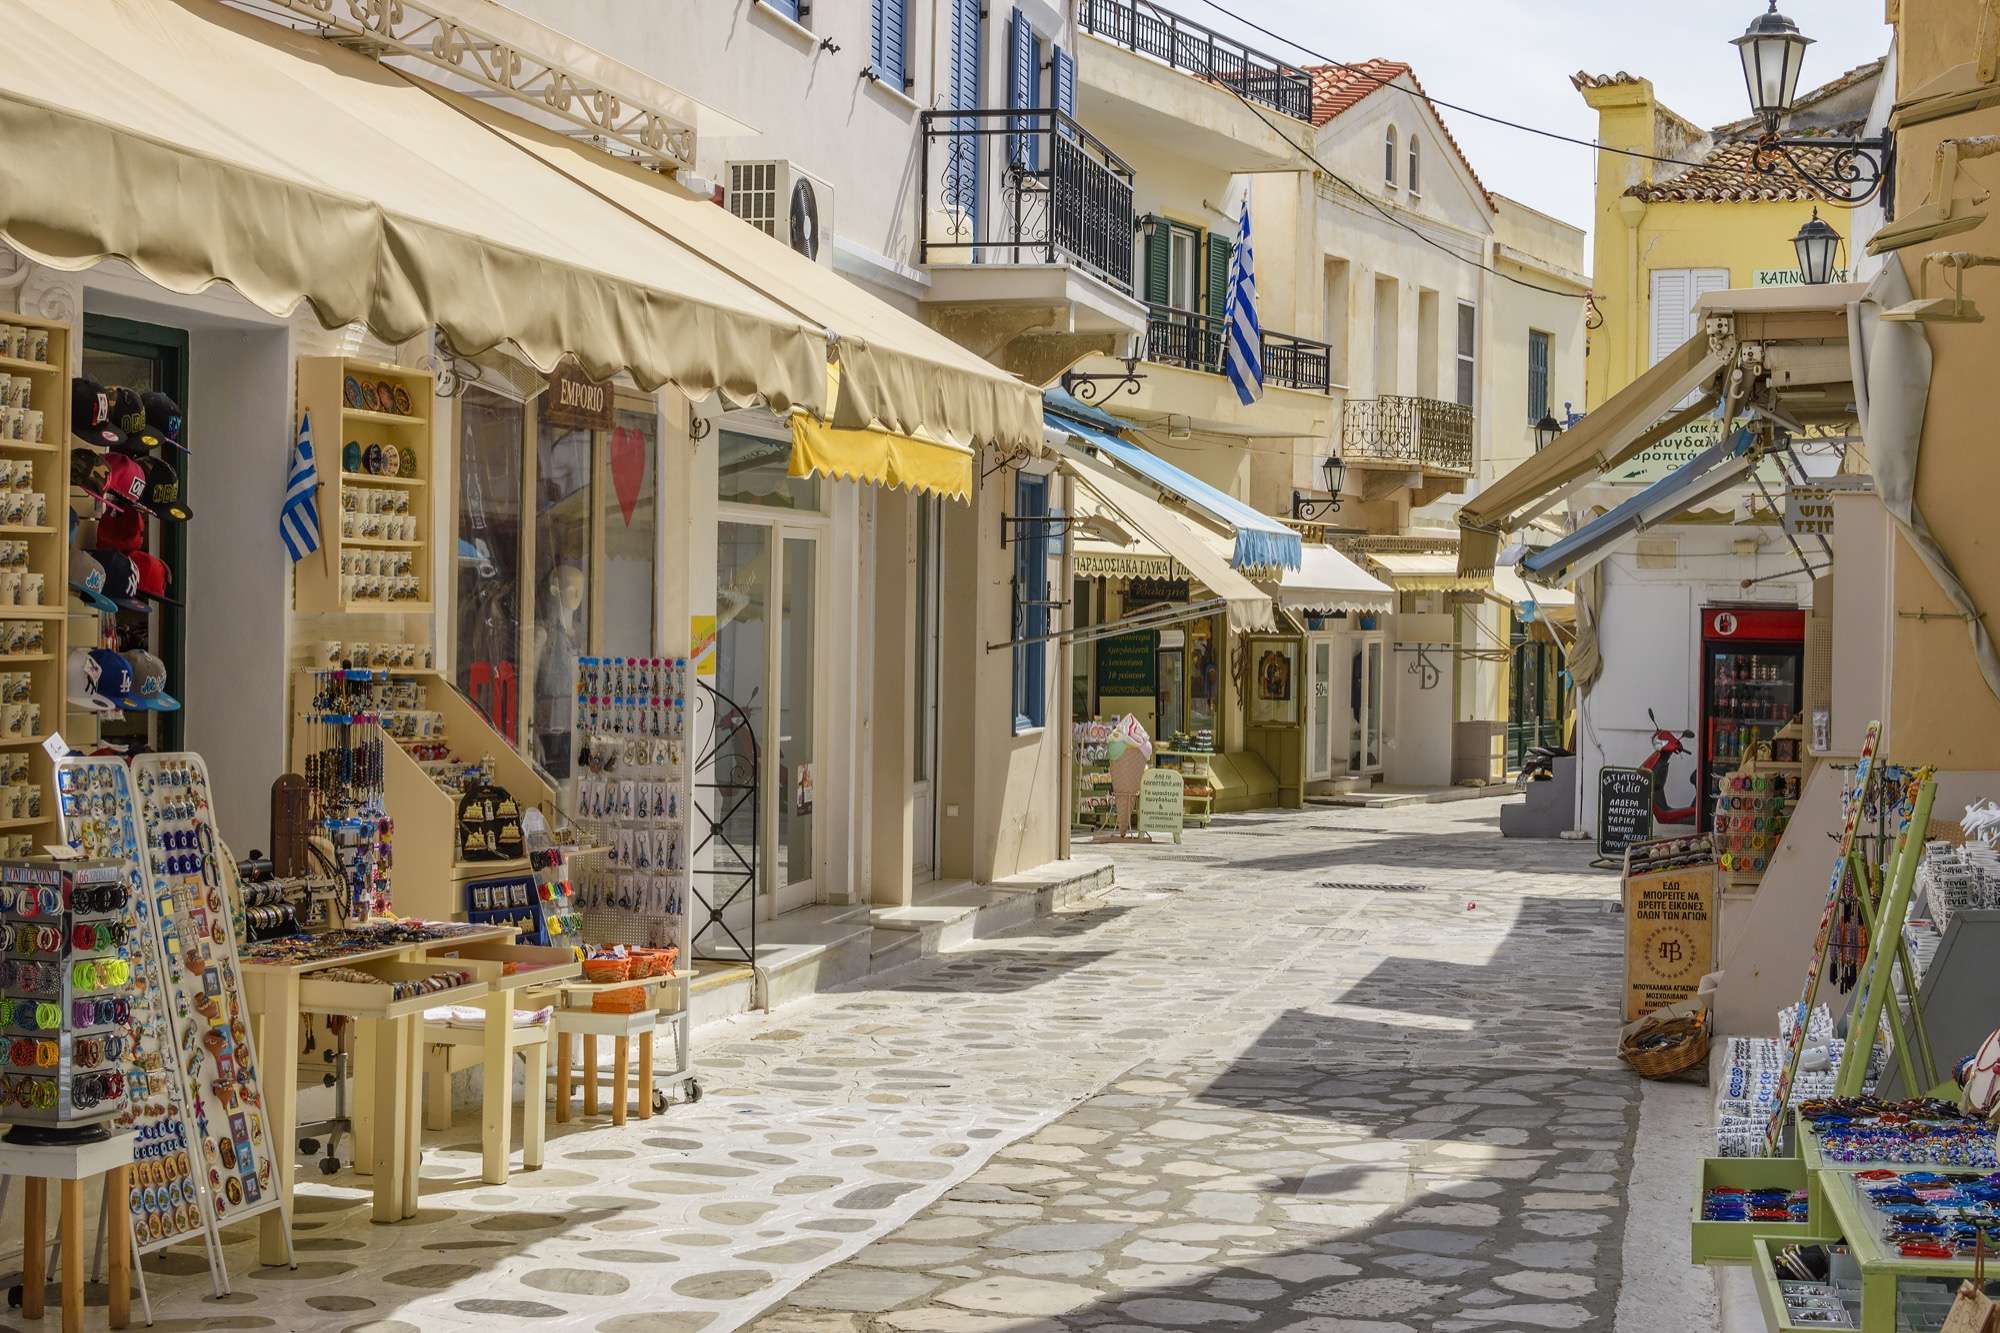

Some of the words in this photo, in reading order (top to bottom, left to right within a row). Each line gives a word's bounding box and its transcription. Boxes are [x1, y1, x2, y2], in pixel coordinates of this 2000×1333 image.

[560, 378, 604, 412] EMPORIO
[1800, 505, 1834, 518] ΨΙΛ
[1140, 559, 1169, 575] ΓΛΥΚΑ
[1603, 774, 1649, 786] ΕΣΤΙΑΤΟΡΙΟ
[1610, 799, 1639, 807] ΛΑΔΕΡΑ
[1608, 807, 1648, 817] ΜΑΓΕΙΡΕΥΤΑ
[1608, 816, 1635, 825] ΨΑΡΙΚΑ
[1663, 881, 1680, 890] ΕΔΩ
[1643, 891, 1686, 900] ΜΠΟΡΕΙΤΕ
[1688, 892, 1699, 900] ΝΑ
[1638, 901, 1667, 910] ΒΡΕΙΤΕ
[1668, 901, 1704, 911] ΕΙΚΟΝΕΣ
[1637, 911, 1660, 920] ΟΛΩΝ
[1662, 911, 1680, 920] ΤΩΝ
[1681, 912, 1707, 921] ΑΓΙΩΝ
[1633, 983, 1672, 992] ΜΠΟΥΚΑΛΑΚΙΑ
[1673, 984, 1700, 993] ΑΓΙΑΣΜΟ
[1646, 991, 1688, 1000] ΜΟΣΧΟΛΙΒΑΝΟ
